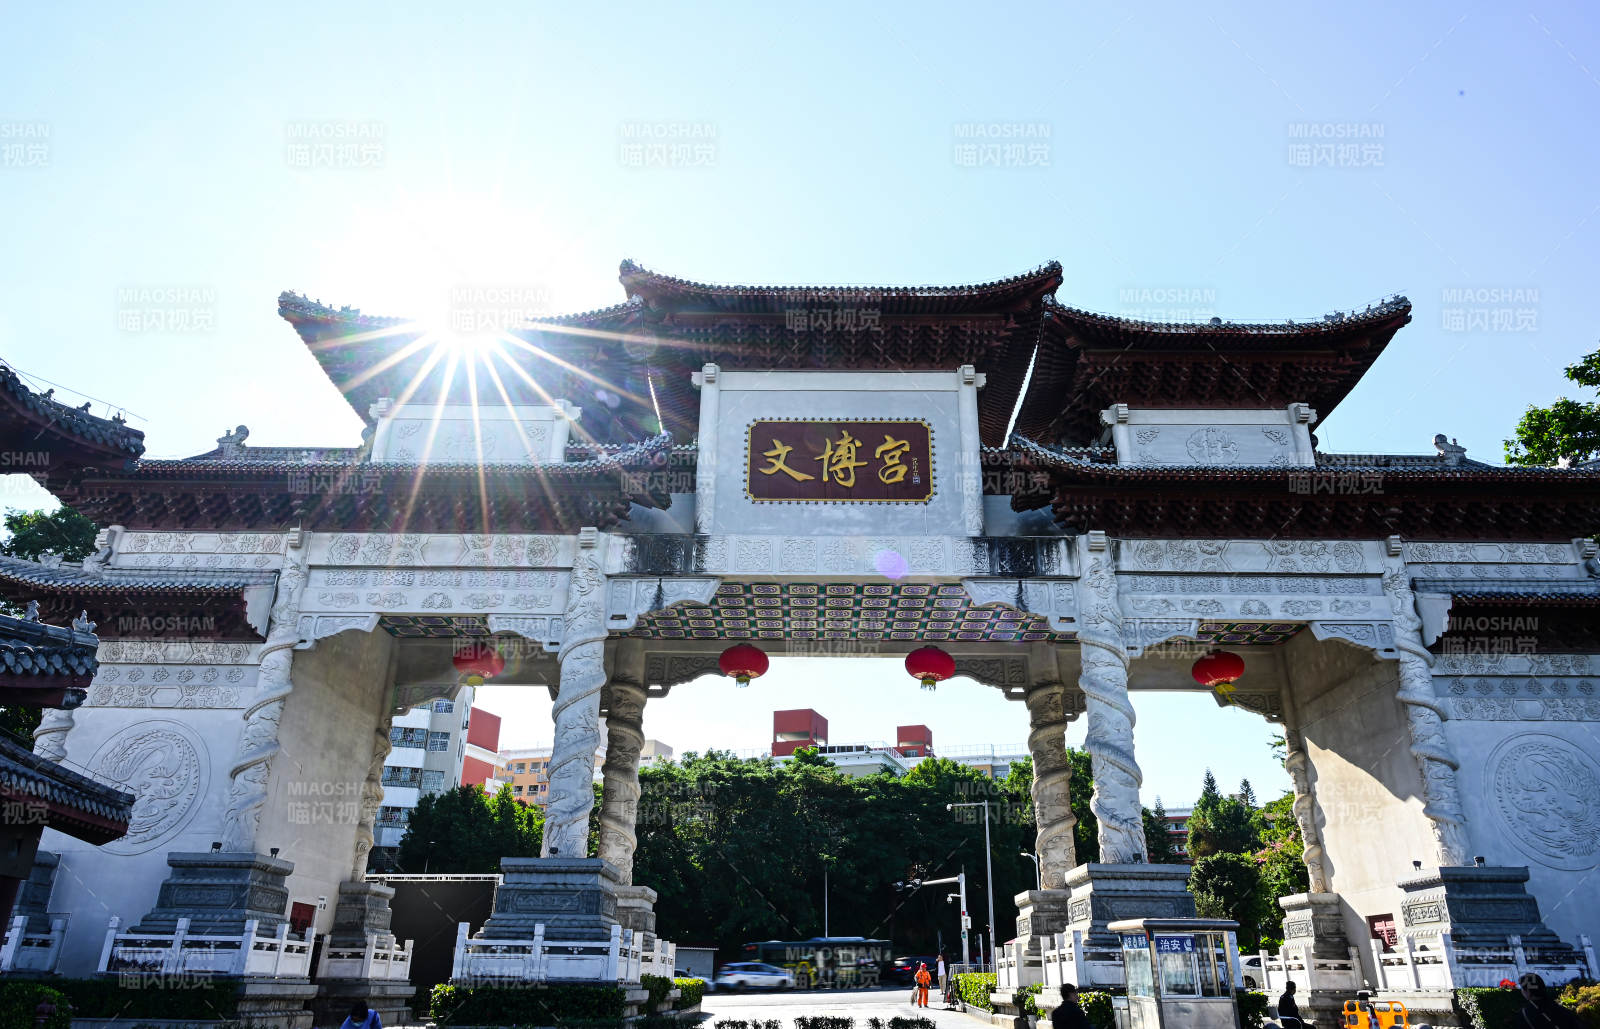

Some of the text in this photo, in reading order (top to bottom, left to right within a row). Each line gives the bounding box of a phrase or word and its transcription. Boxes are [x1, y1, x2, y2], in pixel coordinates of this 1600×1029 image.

[758, 429, 911, 489] 文博宫
[1160, 939, 1181, 951] 治安
